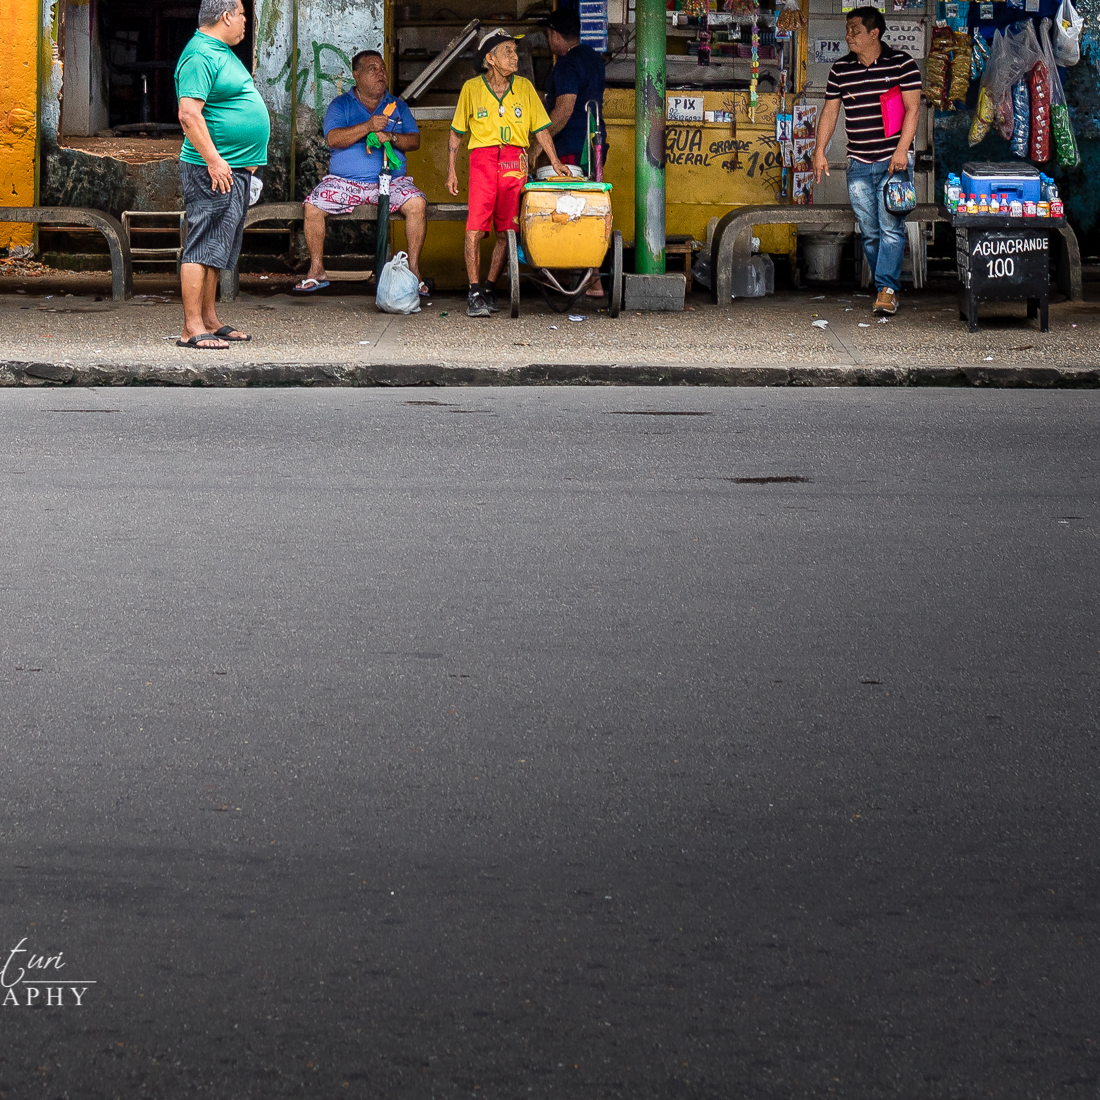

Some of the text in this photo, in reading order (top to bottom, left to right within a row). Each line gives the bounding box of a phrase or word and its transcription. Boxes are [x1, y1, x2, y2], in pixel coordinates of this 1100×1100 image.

[821, 41, 841, 52] PIX
[674, 98, 696, 111] PIX
[500, 125, 512, 143] 10
[665, 128, 753, 155] GUA GRANDE
[665, 152, 712, 167] NERAL
